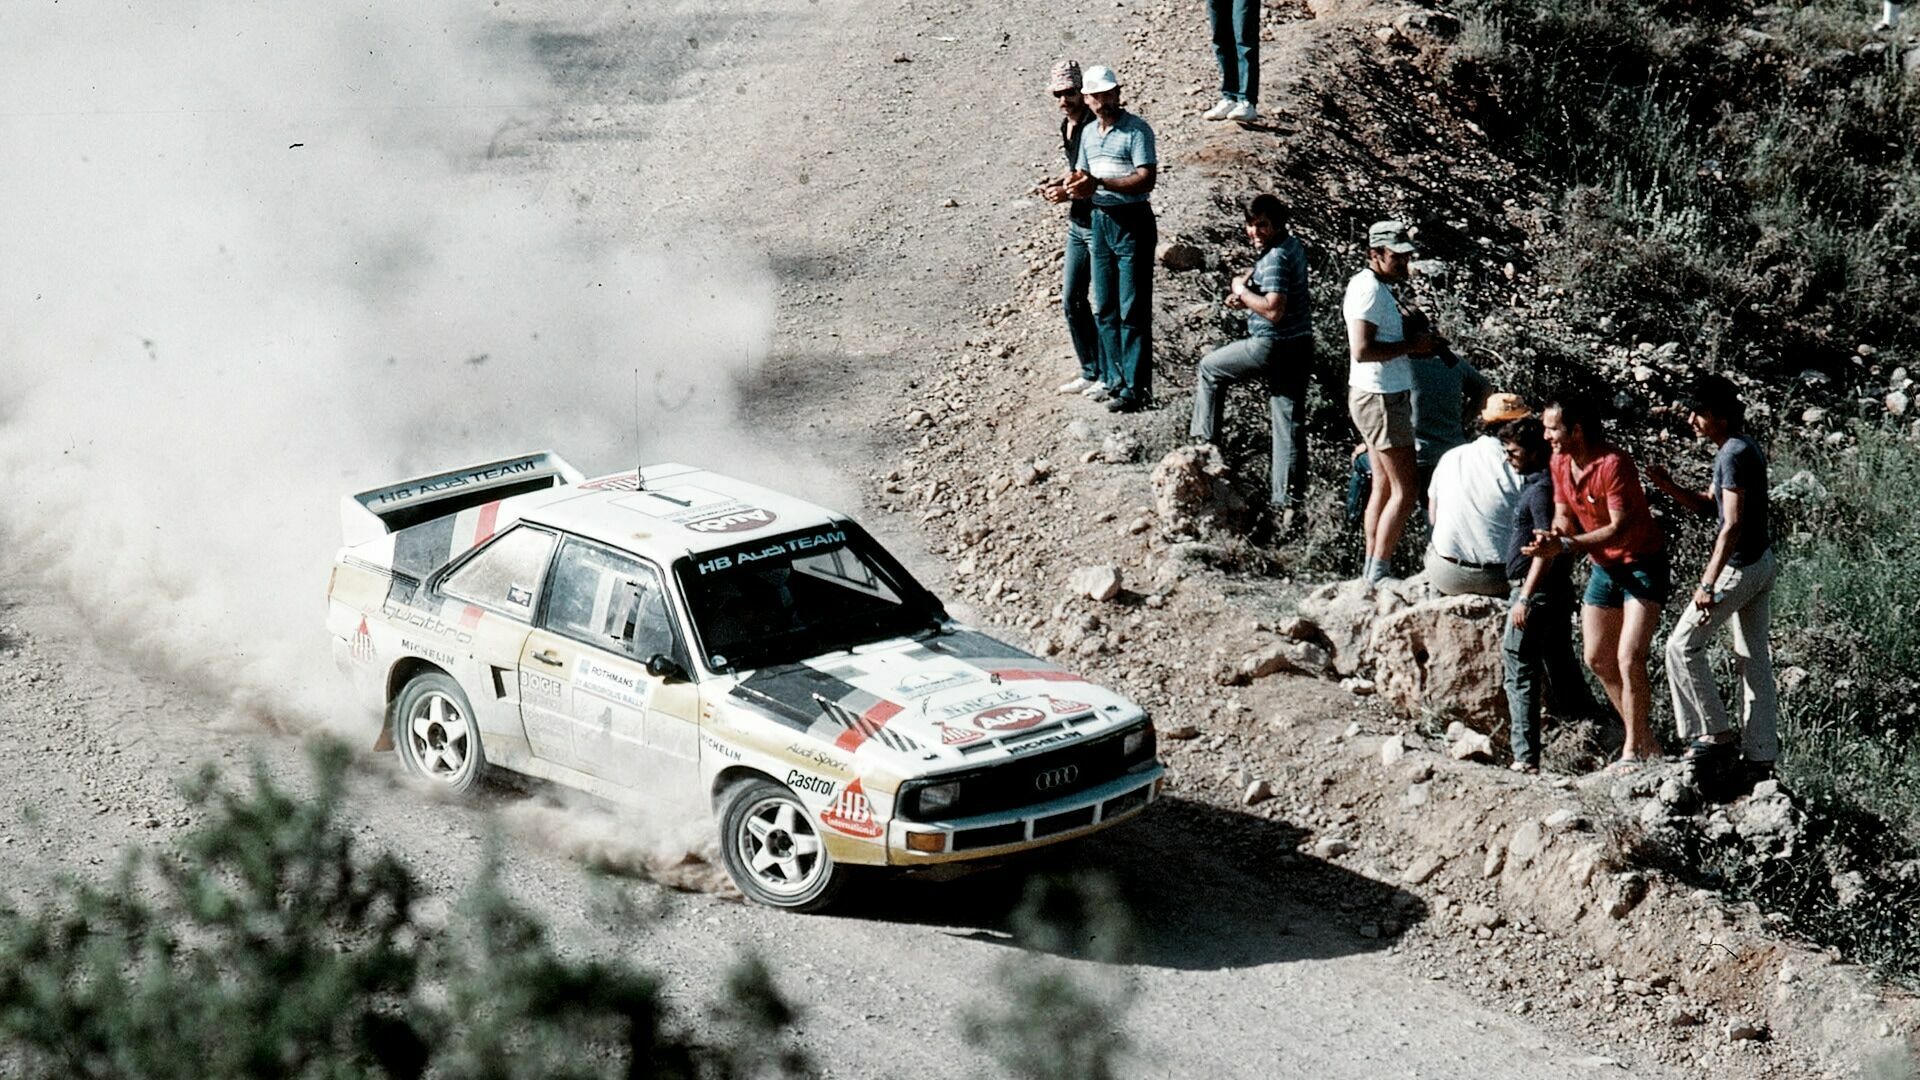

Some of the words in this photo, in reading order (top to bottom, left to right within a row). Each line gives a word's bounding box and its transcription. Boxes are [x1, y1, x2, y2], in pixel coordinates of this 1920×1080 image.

[379, 490, 412, 504] HB
[469, 460, 536, 482] TEAM
[698, 556, 733, 575] HB
[785, 531, 847, 552] TEAM
[384, 605, 473, 645] quattro
[401, 639, 455, 665] MICHELIN
[520, 670, 562, 697] BOGE
[591, 666, 634, 689] ROTHMANS
[1006, 730, 1083, 754] MICHELIN
[786, 743, 813, 759] Audi
[814, 751, 848, 772] Sport
[786, 769, 836, 797] Castrol
[835, 790, 871, 823] HB
